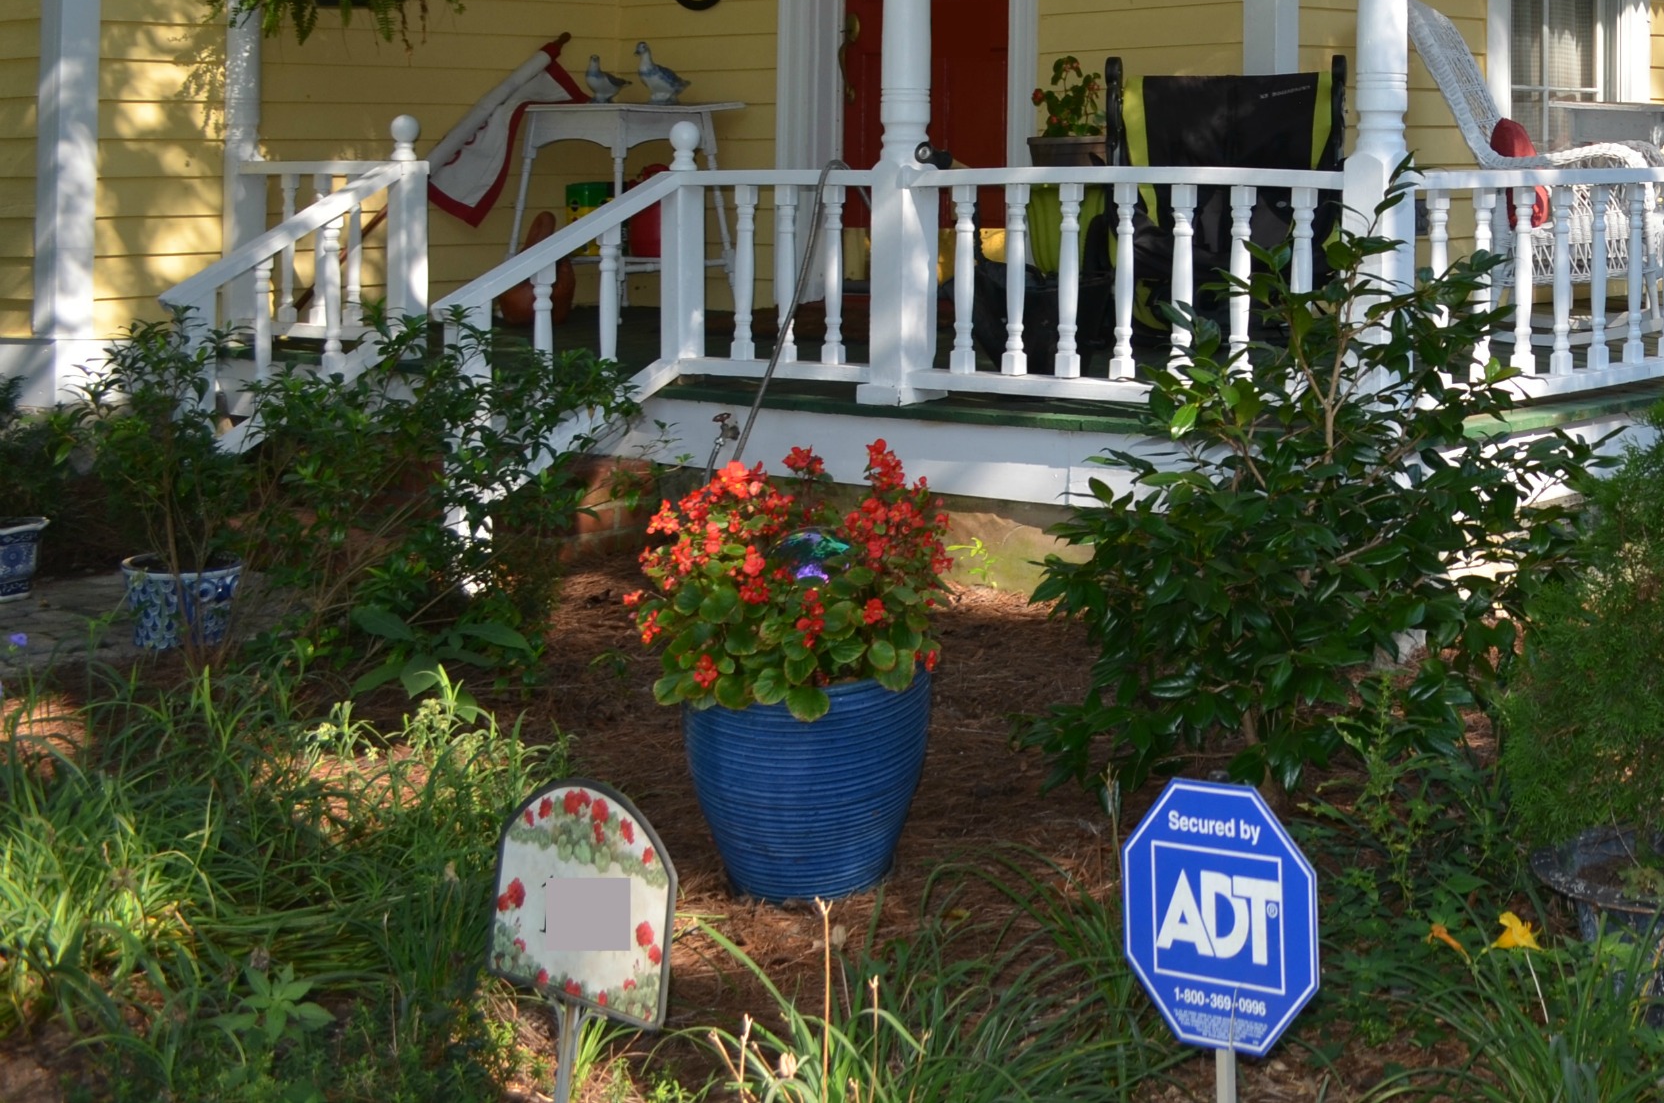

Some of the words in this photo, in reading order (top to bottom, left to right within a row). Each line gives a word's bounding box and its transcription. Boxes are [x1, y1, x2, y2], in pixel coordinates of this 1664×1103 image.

[1168, 810, 1235, 838] Secured
[1239, 820, 1260, 845] by
[1156, 868, 1280, 965] ADT
